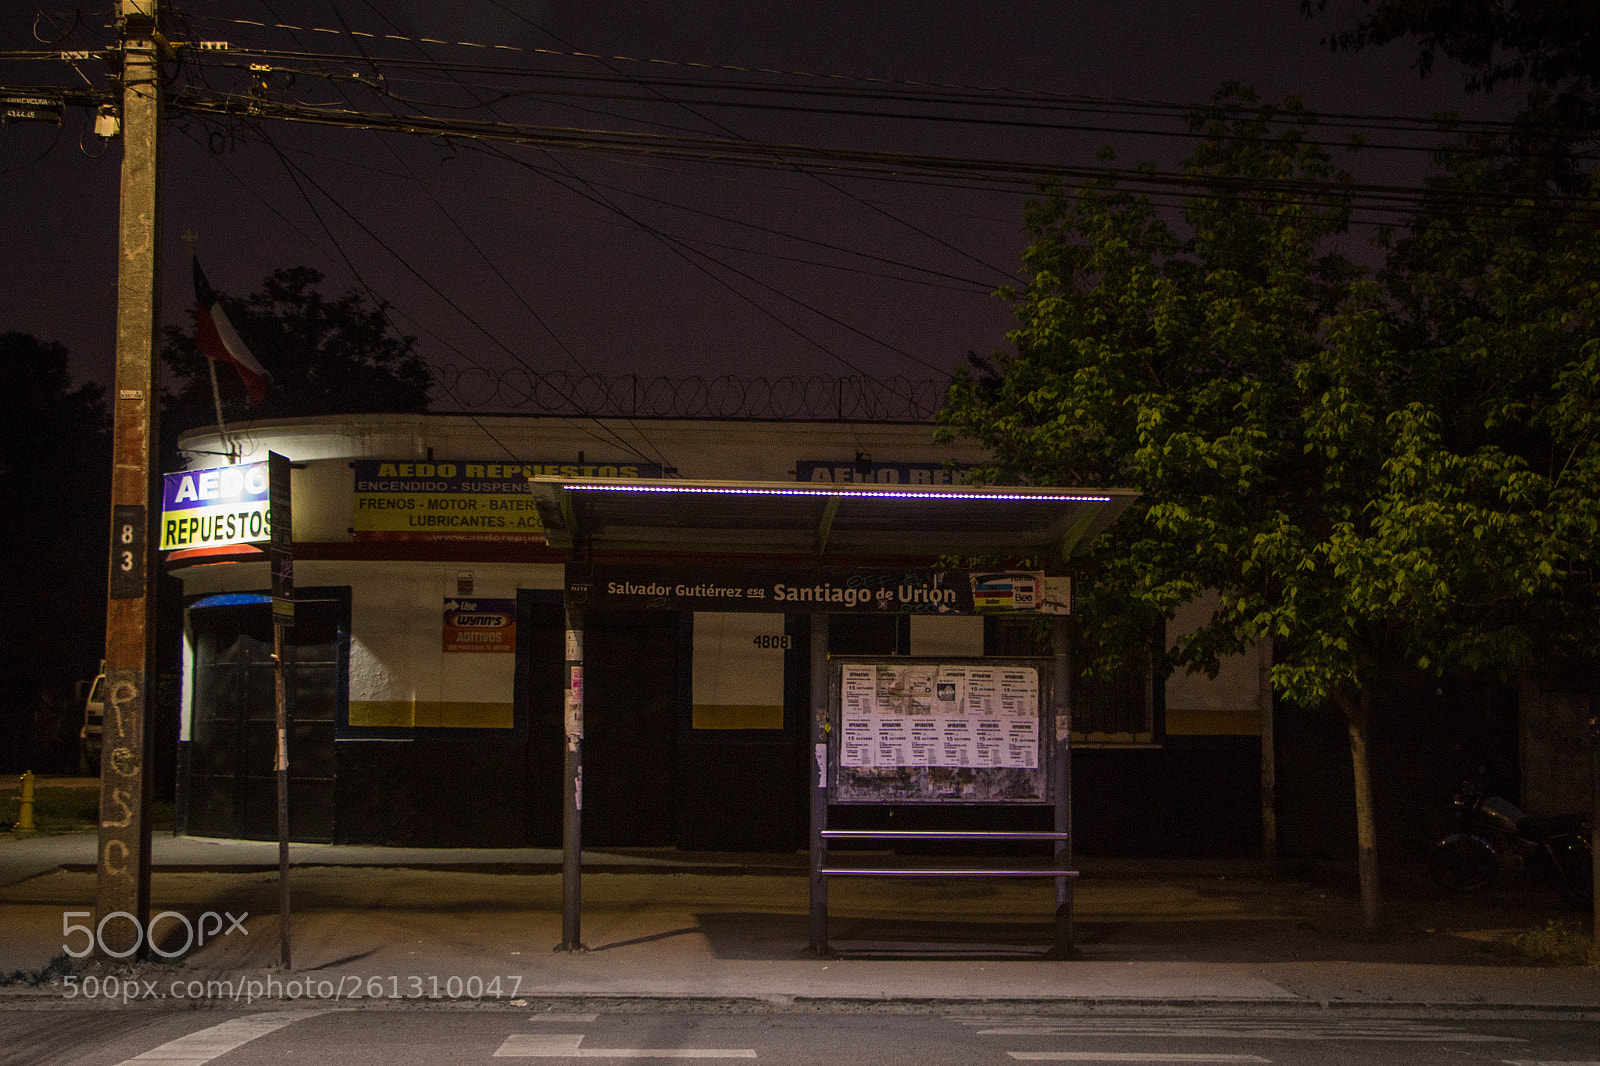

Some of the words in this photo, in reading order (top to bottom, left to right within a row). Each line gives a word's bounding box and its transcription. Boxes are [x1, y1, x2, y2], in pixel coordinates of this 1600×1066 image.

[378, 463, 457, 478] AEDO
[465, 464, 638, 479] REPUESTOS
[174, 466, 269, 503] AEDO
[357, 481, 448, 491] ENCENDIDO
[461, 482, 530, 492] SUSPENS
[359, 498, 415, 510] FRENOS
[427, 499, 477, 511] MOTOR
[165, 509, 271, 546] REPUESTOS
[409, 515, 505, 527] LUBRICANTES
[607, 581, 672, 596] Salvador
[675, 584, 742, 598] Gutiérrez
[773, 582, 871, 607] Santiago
[875, 587, 894, 600] de
[753, 635, 789, 649] 4808
